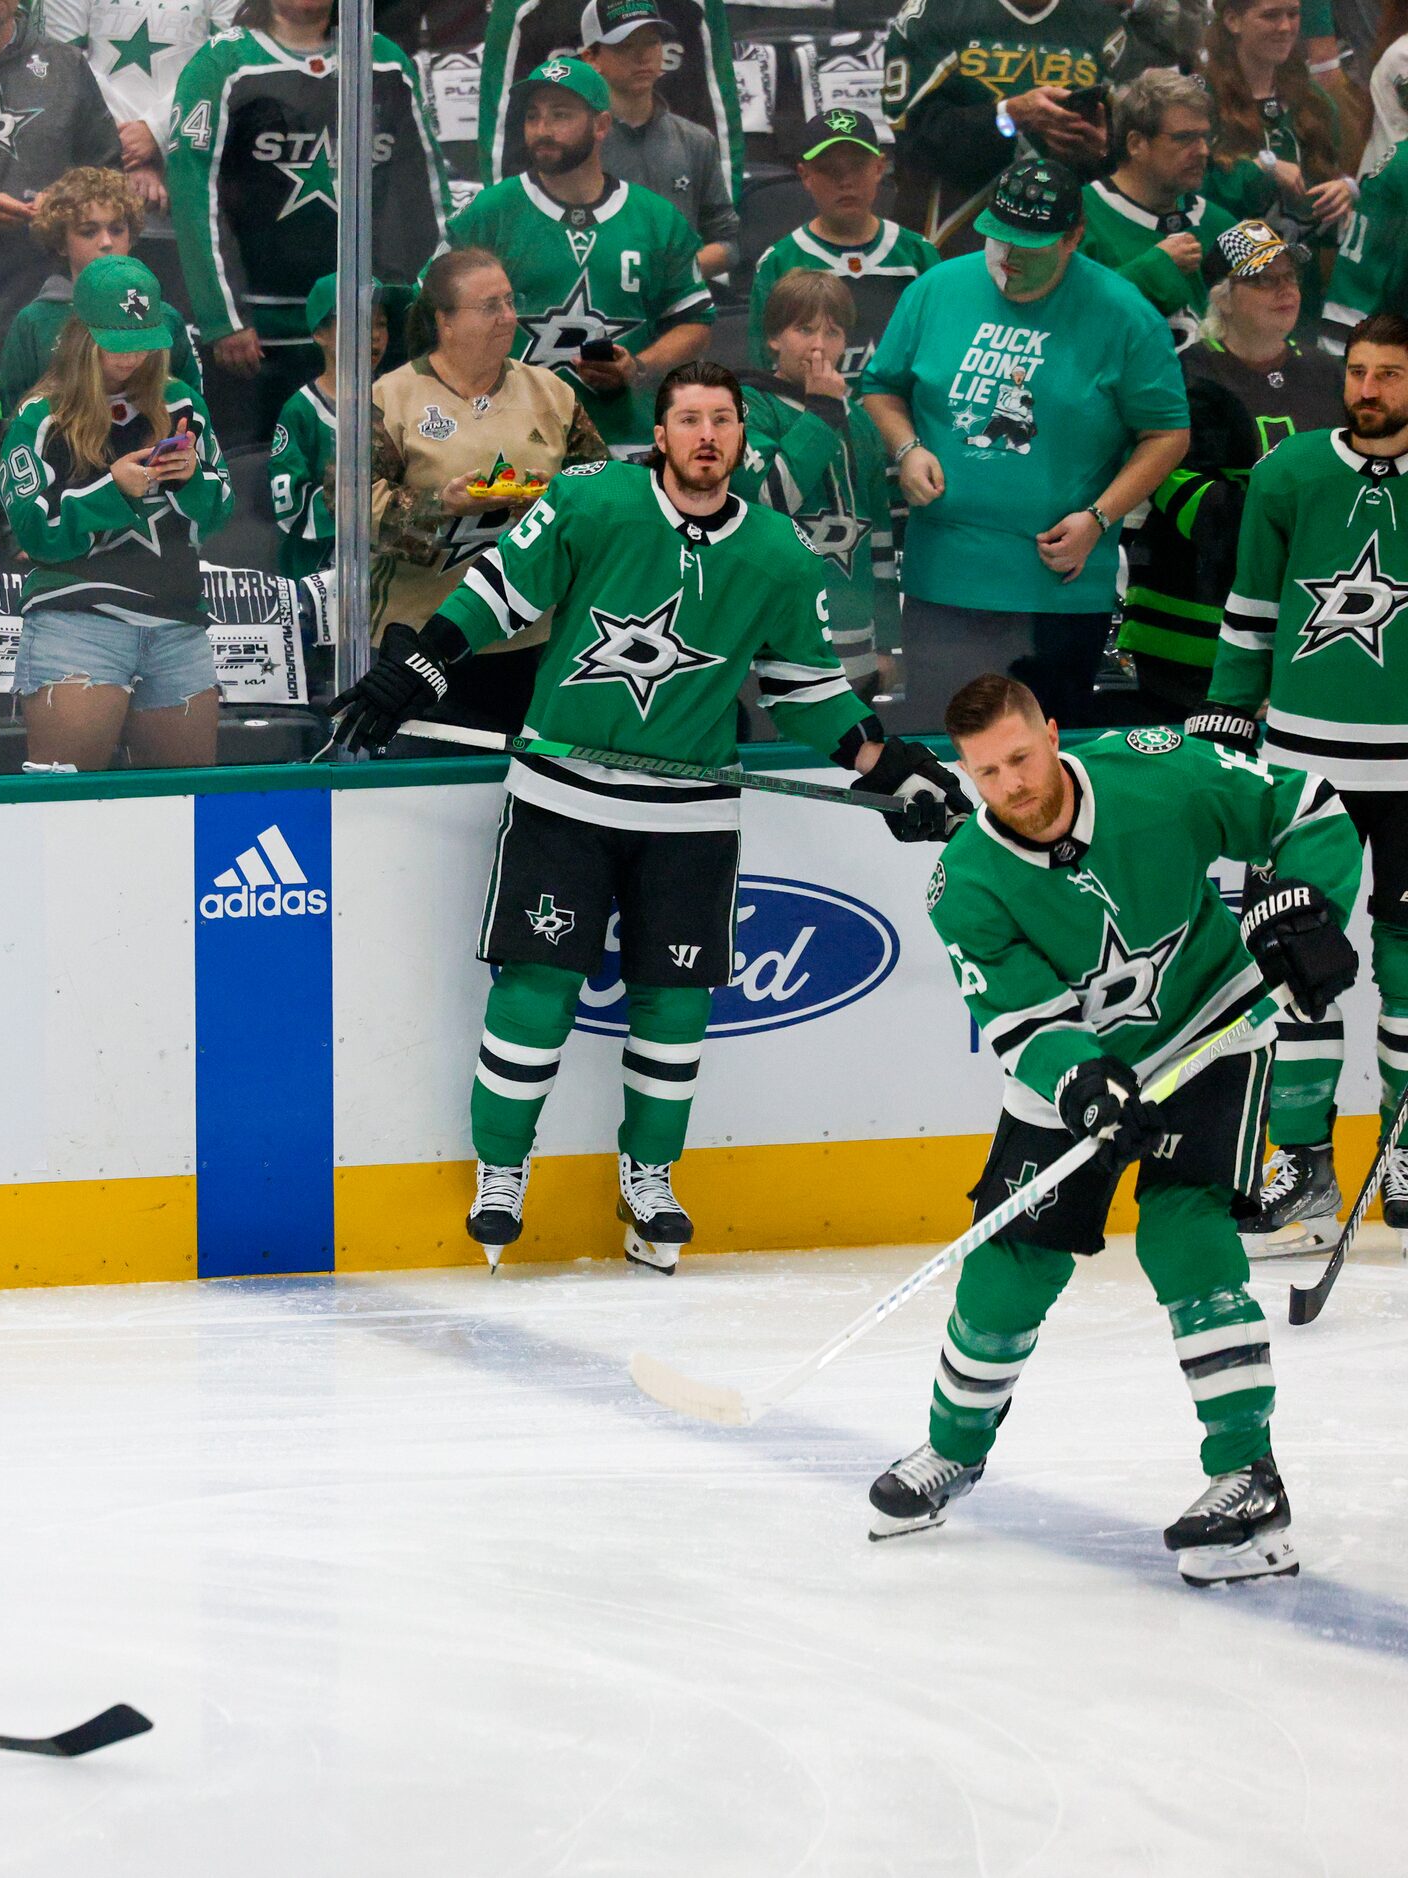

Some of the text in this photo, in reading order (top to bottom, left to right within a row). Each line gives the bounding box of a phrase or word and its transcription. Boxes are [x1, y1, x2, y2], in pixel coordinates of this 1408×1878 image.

[959, 49, 1098, 88] STARS
[620, 250, 641, 293] C
[972, 322, 1052, 356] PUCK
[959, 347, 1044, 382] DON'T
[948, 373, 996, 404] LIE
[423, 419, 457, 432] FINAL
[199, 883, 328, 919] adidas
